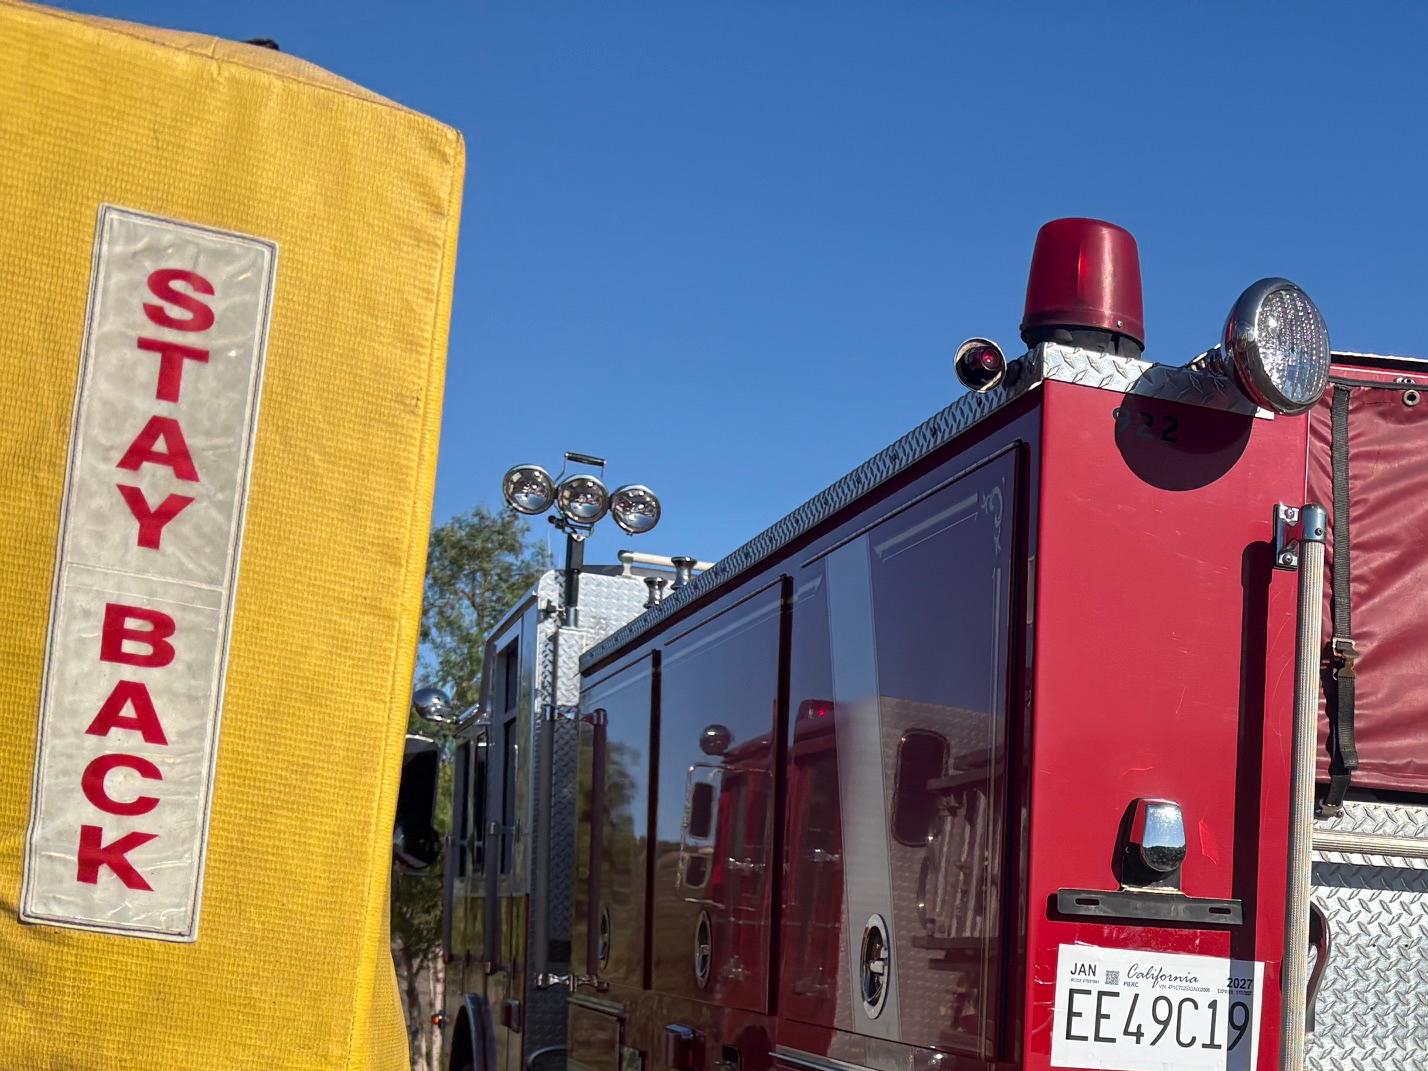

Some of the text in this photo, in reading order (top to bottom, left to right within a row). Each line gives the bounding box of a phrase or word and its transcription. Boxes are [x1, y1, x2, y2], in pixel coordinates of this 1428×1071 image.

[76, 268, 216, 892] STAY BACK
[1070, 962, 1097, 977] JAN
[1127, 963, 1200, 988] California
[1226, 977, 1253, 990] 2027
[1065, 988, 1250, 1051] EE49C19
